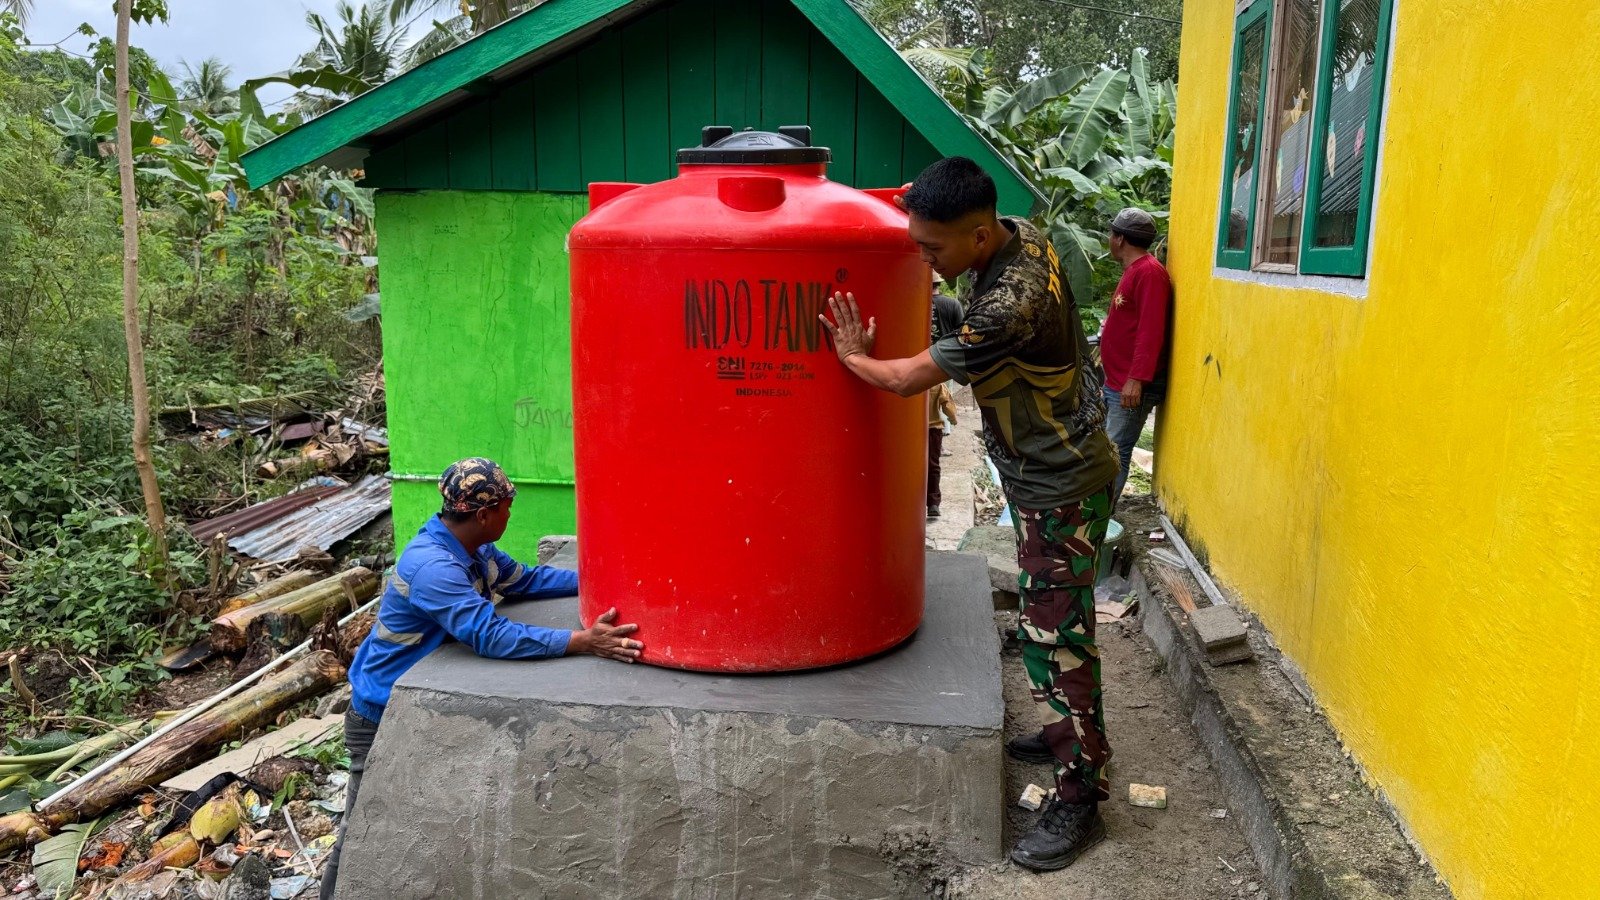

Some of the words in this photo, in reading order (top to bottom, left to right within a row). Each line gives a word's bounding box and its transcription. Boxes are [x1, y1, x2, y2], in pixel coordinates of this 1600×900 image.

[685, 279, 752, 350] INDO
[759, 279, 832, 353] TANK
[717, 356, 745, 370] SNI
